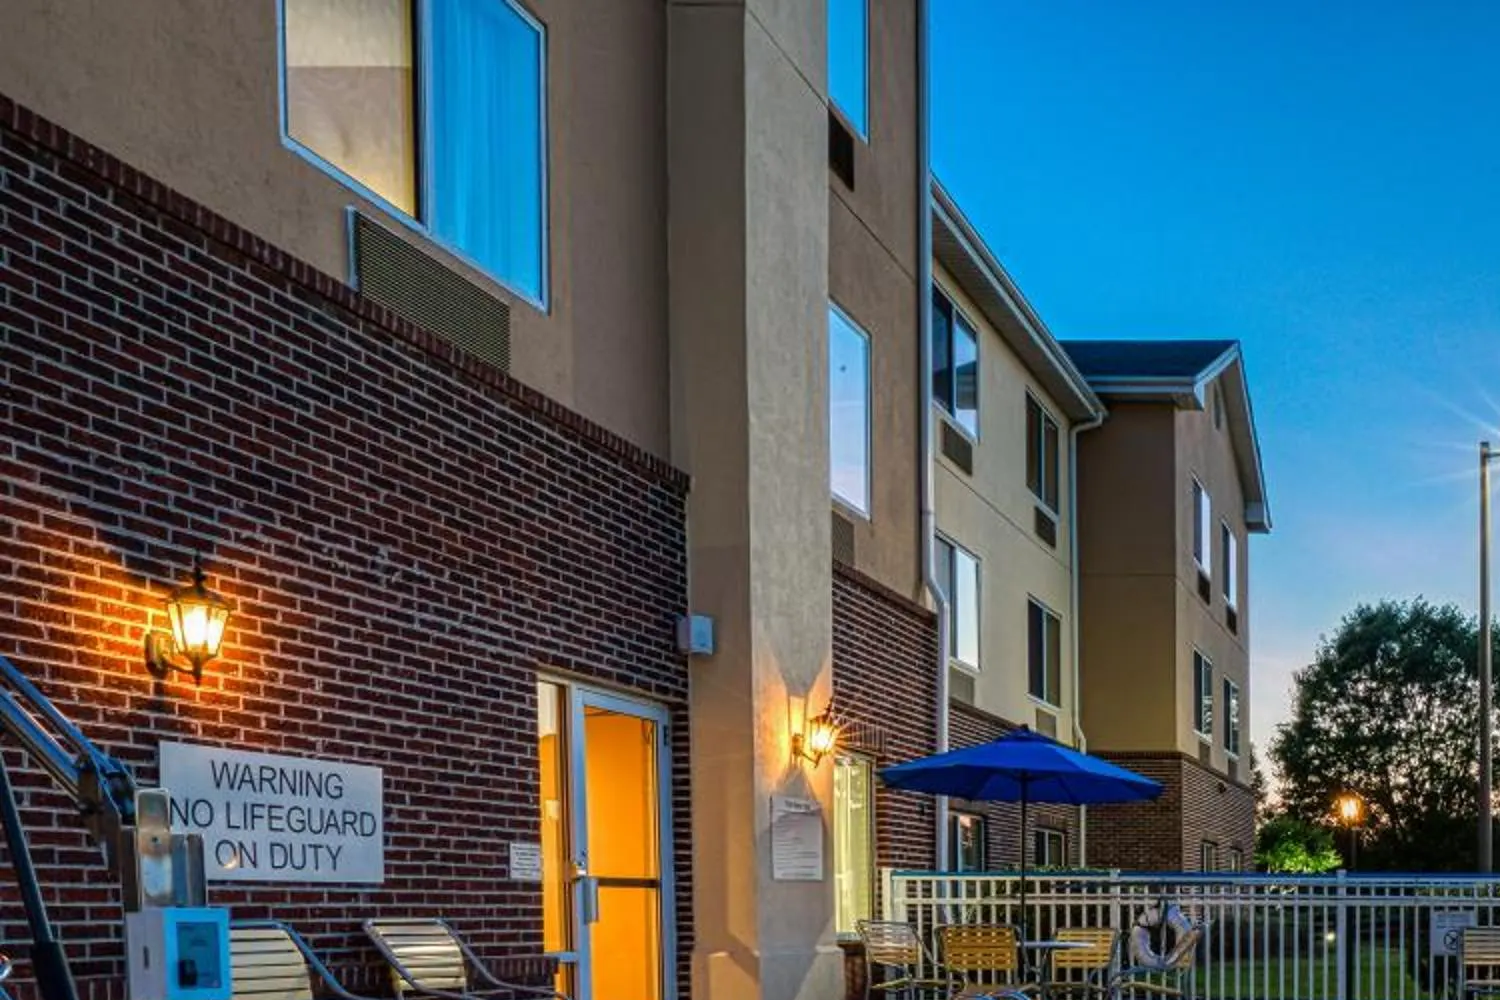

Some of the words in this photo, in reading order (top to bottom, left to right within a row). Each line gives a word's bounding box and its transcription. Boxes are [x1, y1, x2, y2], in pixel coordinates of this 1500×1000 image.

[210, 759, 344, 800] WARNING
[170, 797, 215, 828] NO
[225, 801, 377, 838] LIFEGUARD
[215, 838, 258, 869] ON
[269, 842, 343, 871] DUTY
